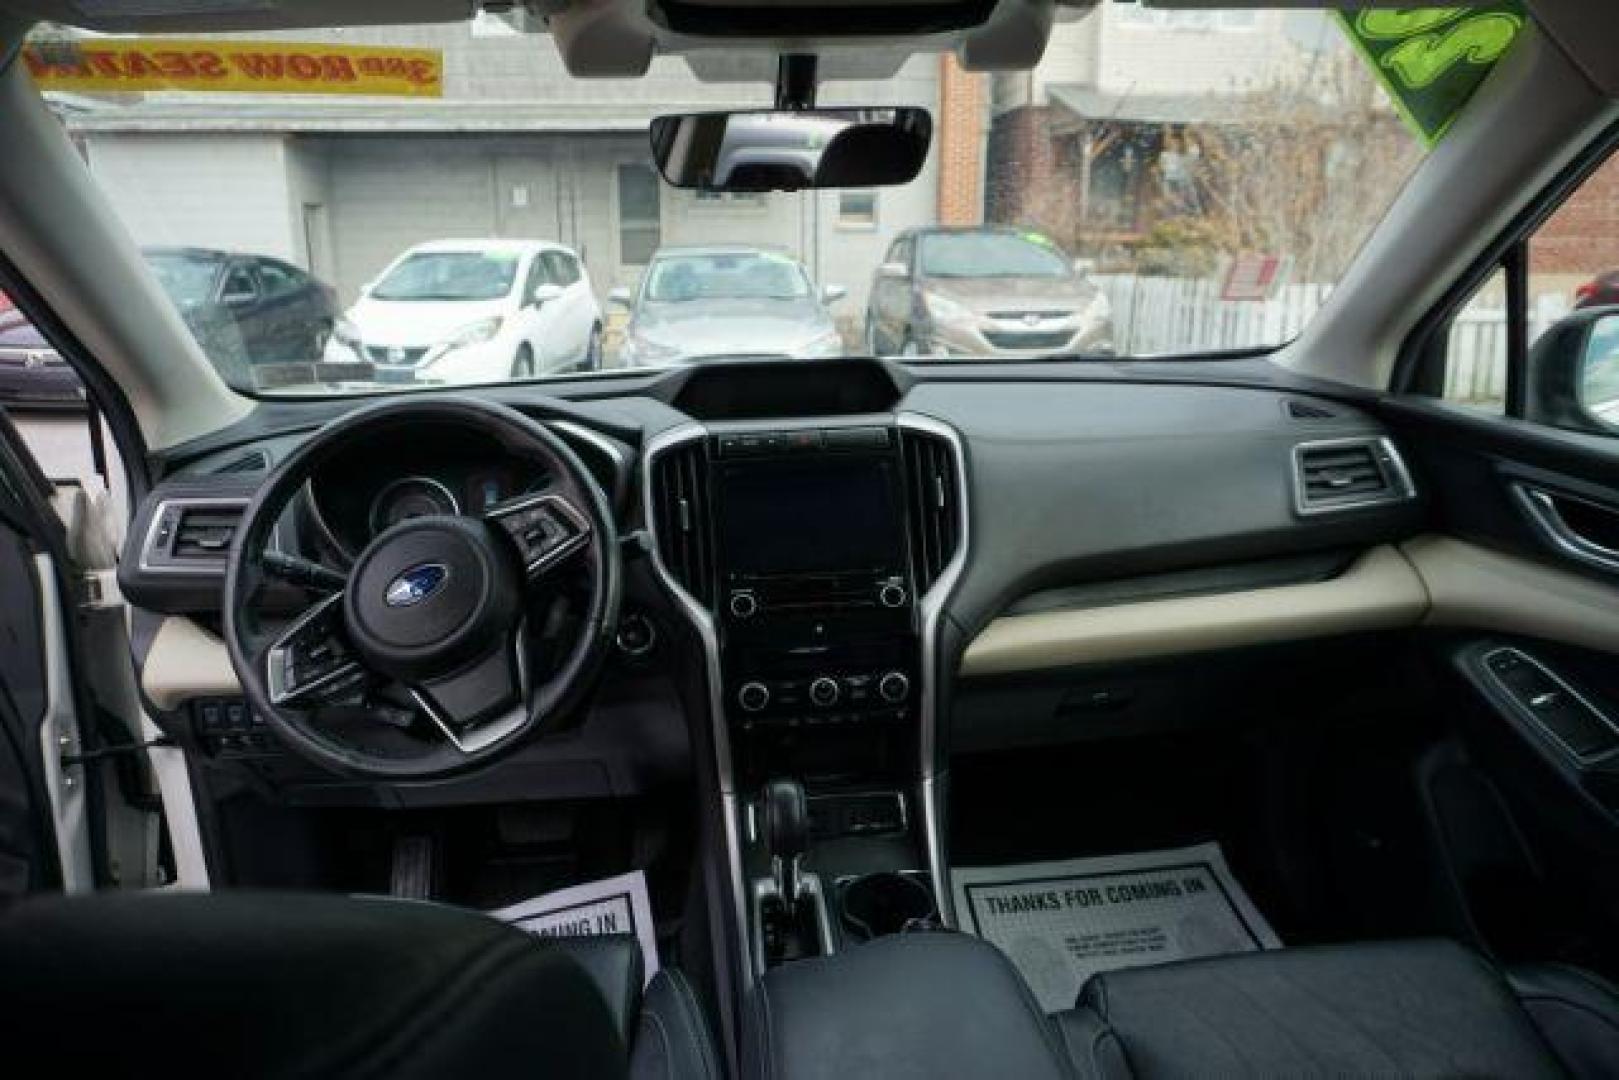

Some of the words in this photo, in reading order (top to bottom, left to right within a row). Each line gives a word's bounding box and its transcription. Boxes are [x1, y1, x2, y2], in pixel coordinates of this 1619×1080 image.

[984, 891, 1061, 914] THANKS
[1064, 887, 1104, 908] FOR
[1106, 880, 1182, 904] COMING
[1183, 878, 1207, 894] IN
[597, 912, 616, 936] IN
